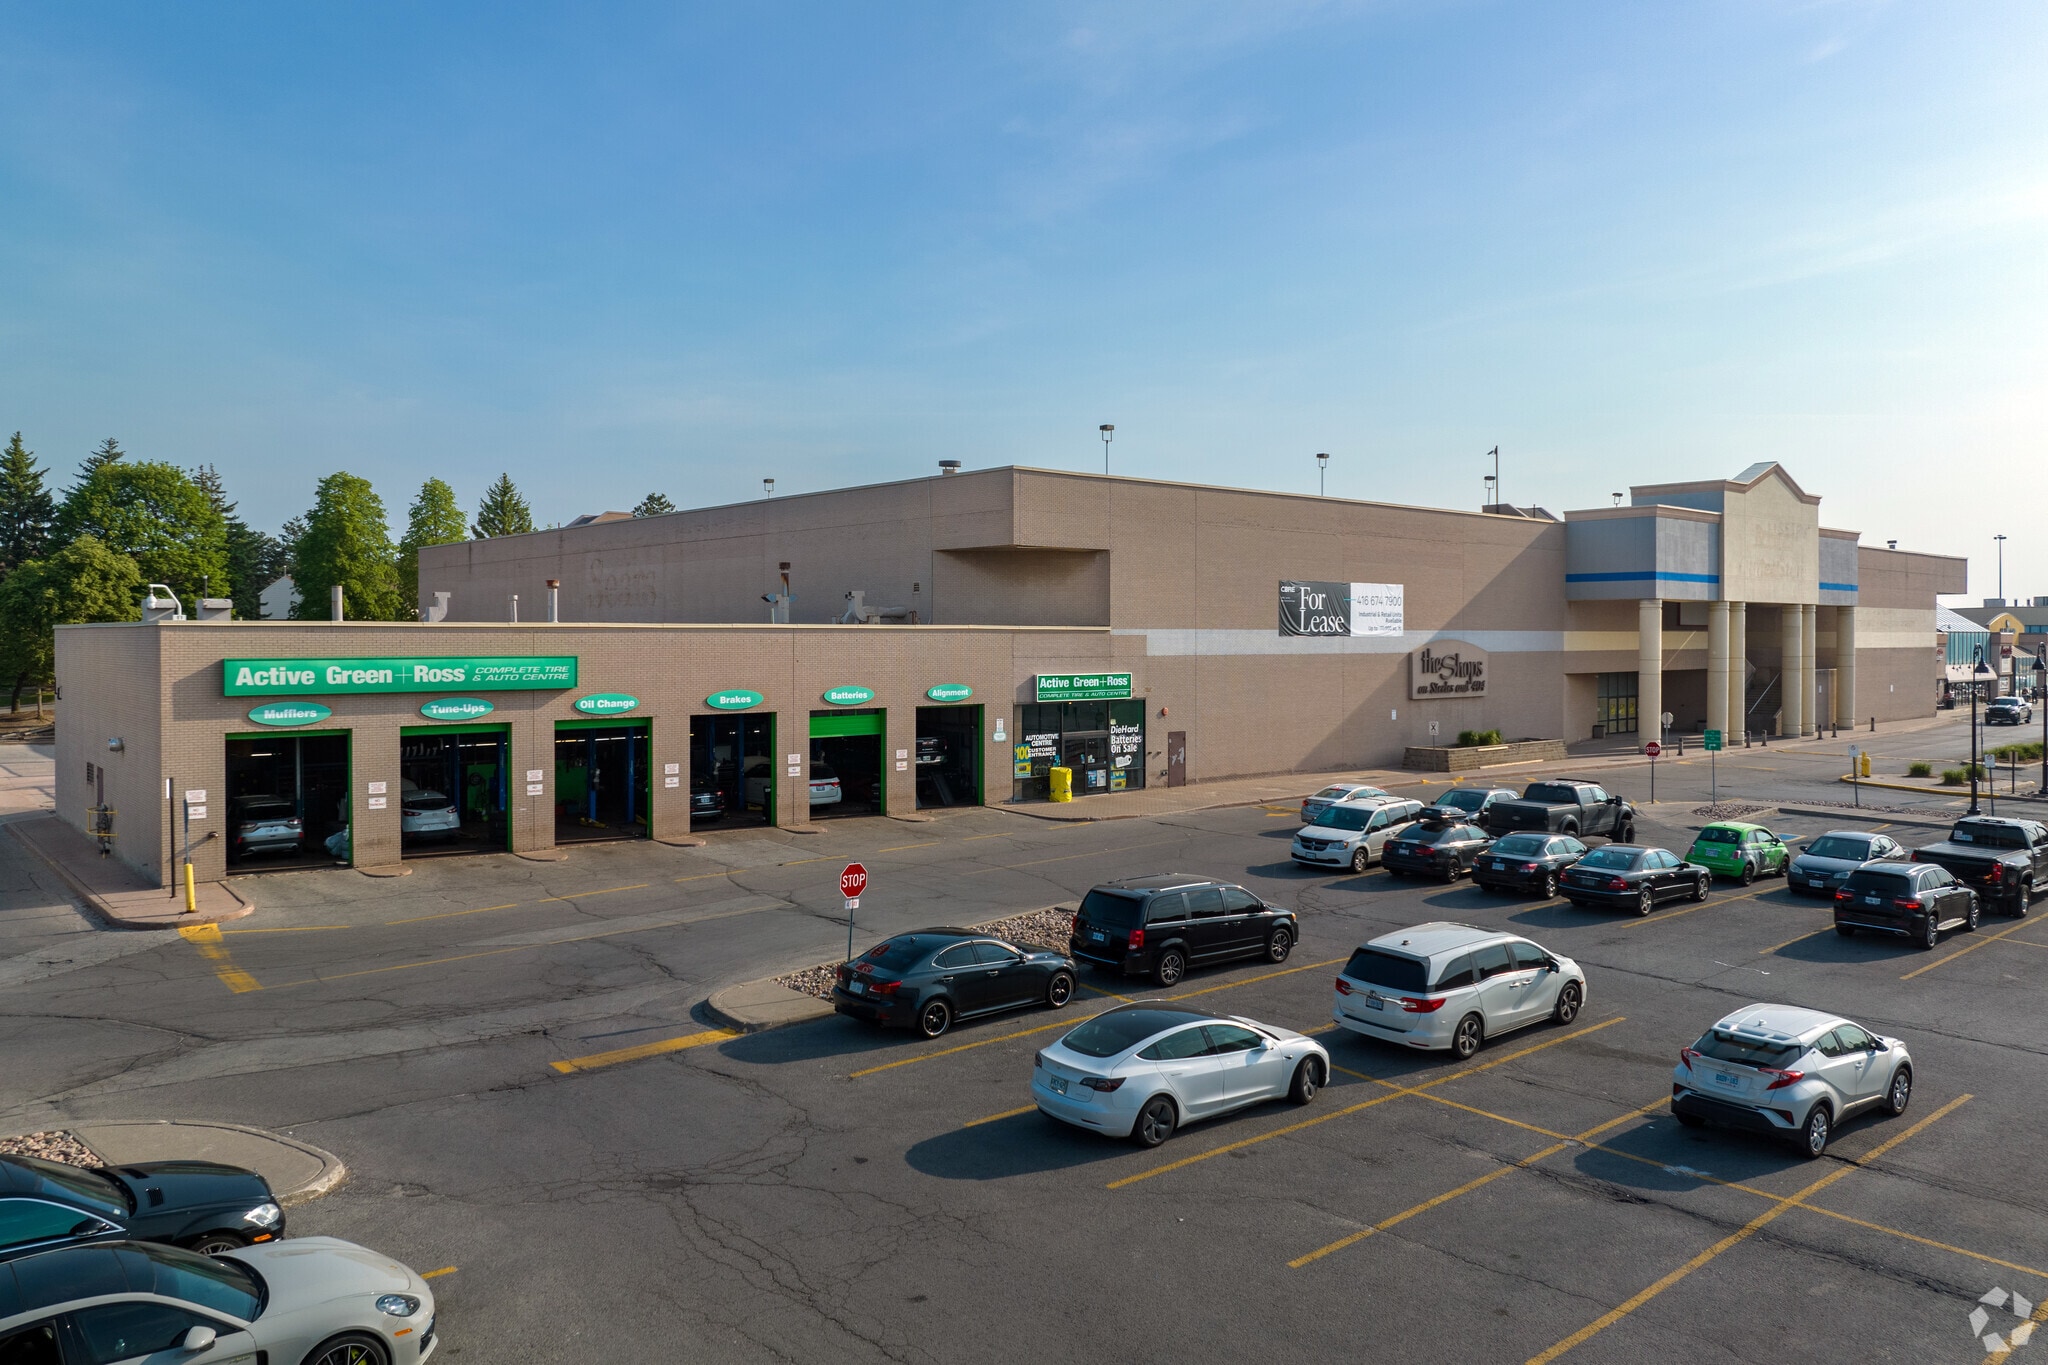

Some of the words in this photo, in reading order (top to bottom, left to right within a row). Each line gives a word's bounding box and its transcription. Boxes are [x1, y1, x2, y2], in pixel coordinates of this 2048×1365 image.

[1299, 586, 1326, 610] For
[1357, 595, 1369, 606] 416
[1370, 595, 1383, 606] 674
[1384, 596, 1402, 607] 7900
[1299, 609, 1345, 633] Lease
[475, 666, 541, 674] COMPLETE
[544, 665, 569, 673] TIRE
[235, 666, 315, 686] Active
[1040, 677, 1069, 688] Active
[831, 691, 868, 700] Batteries
[932, 688, 968, 697] Alignment
[580, 700, 594, 709] Oil
[597, 699, 635, 709] Change
[719, 695, 751, 704] Brakes
[264, 709, 317, 719] Mufflers
[431, 704, 485, 715] Tune-Ups
[1110, 724, 1139, 734] DieHard
[1025, 733, 1059, 741] AUTOMOTIVE
[1111, 734, 1142, 745] Batteries
[1111, 744, 1121, 753] On
[1123, 743, 1137, 753] Sale
[1646, 745, 1660, 754] STOP
[842, 873, 866, 888] STOP
